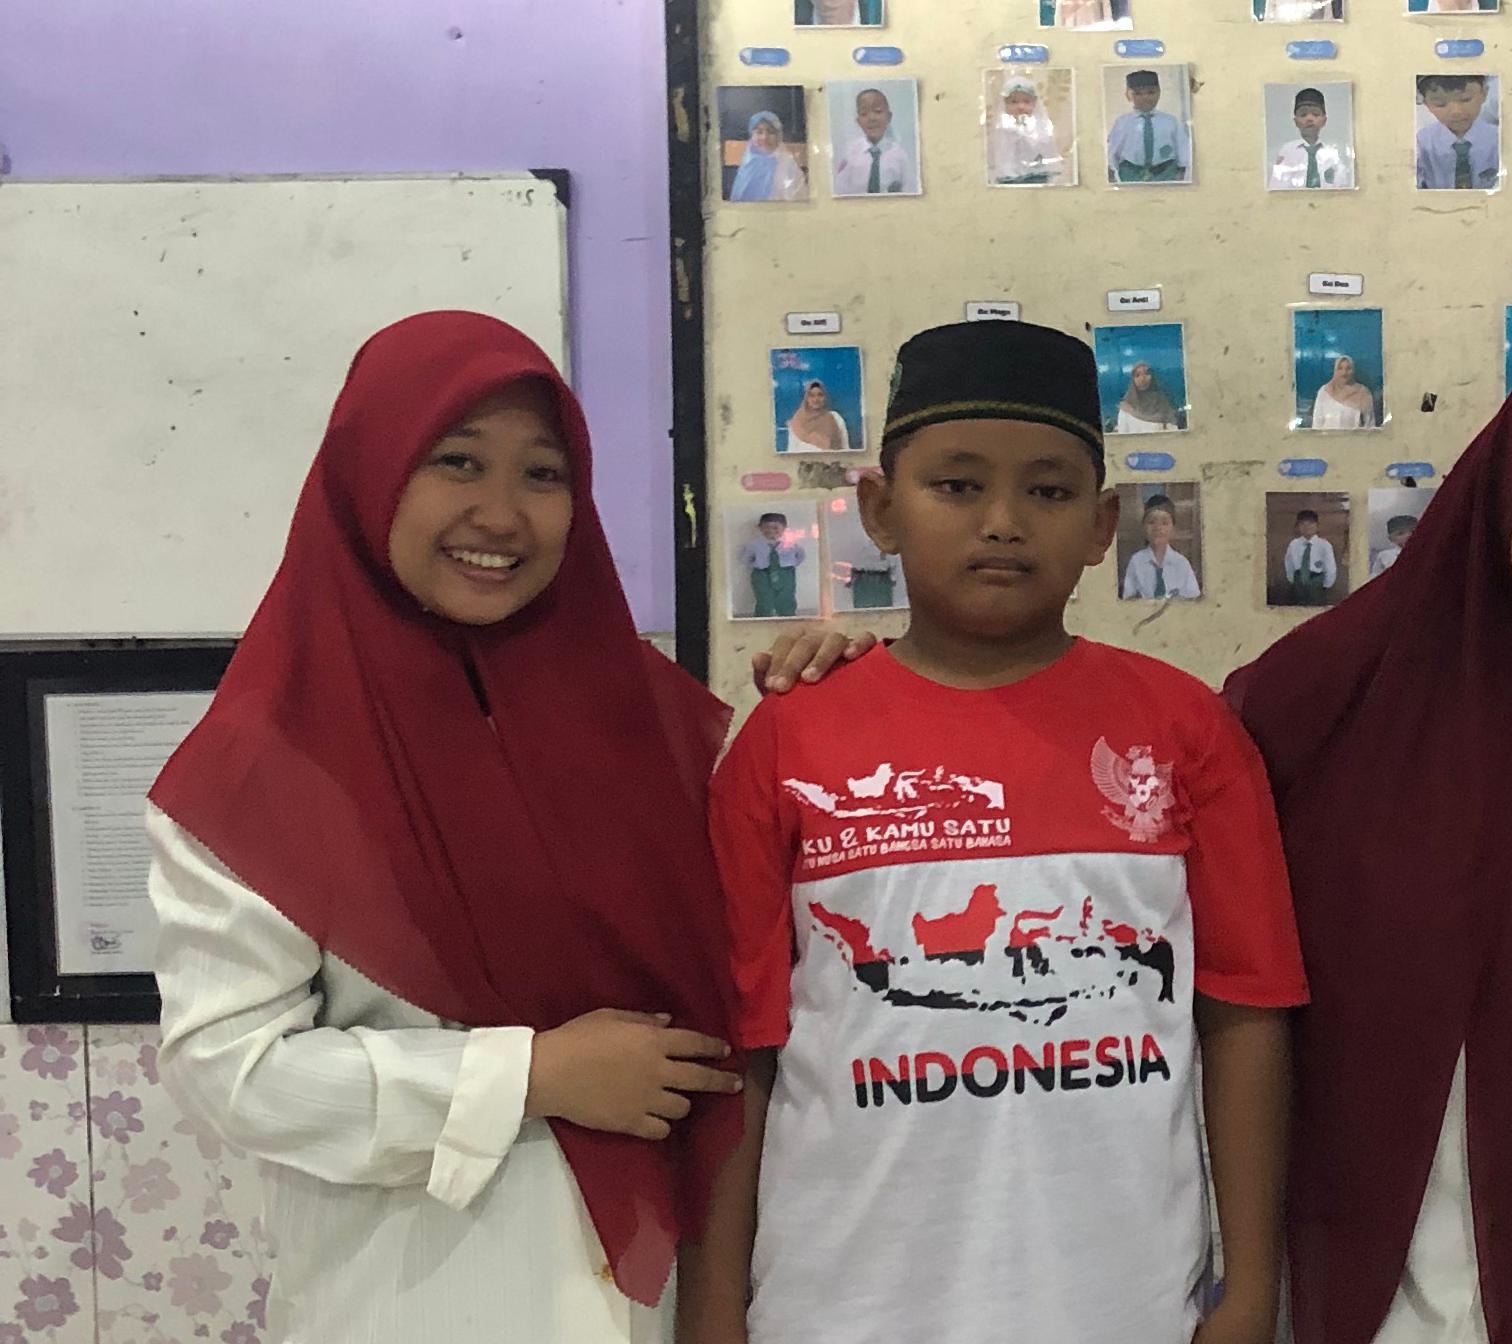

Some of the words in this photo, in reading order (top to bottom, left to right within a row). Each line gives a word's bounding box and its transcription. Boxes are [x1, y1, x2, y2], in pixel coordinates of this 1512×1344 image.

[802, 837, 832, 855] KU
[866, 820, 935, 842] KAMU
[943, 817, 1011, 836] SATU
[930, 837, 963, 850] SATU
[852, 1033, 1171, 1108] INDONESIA
